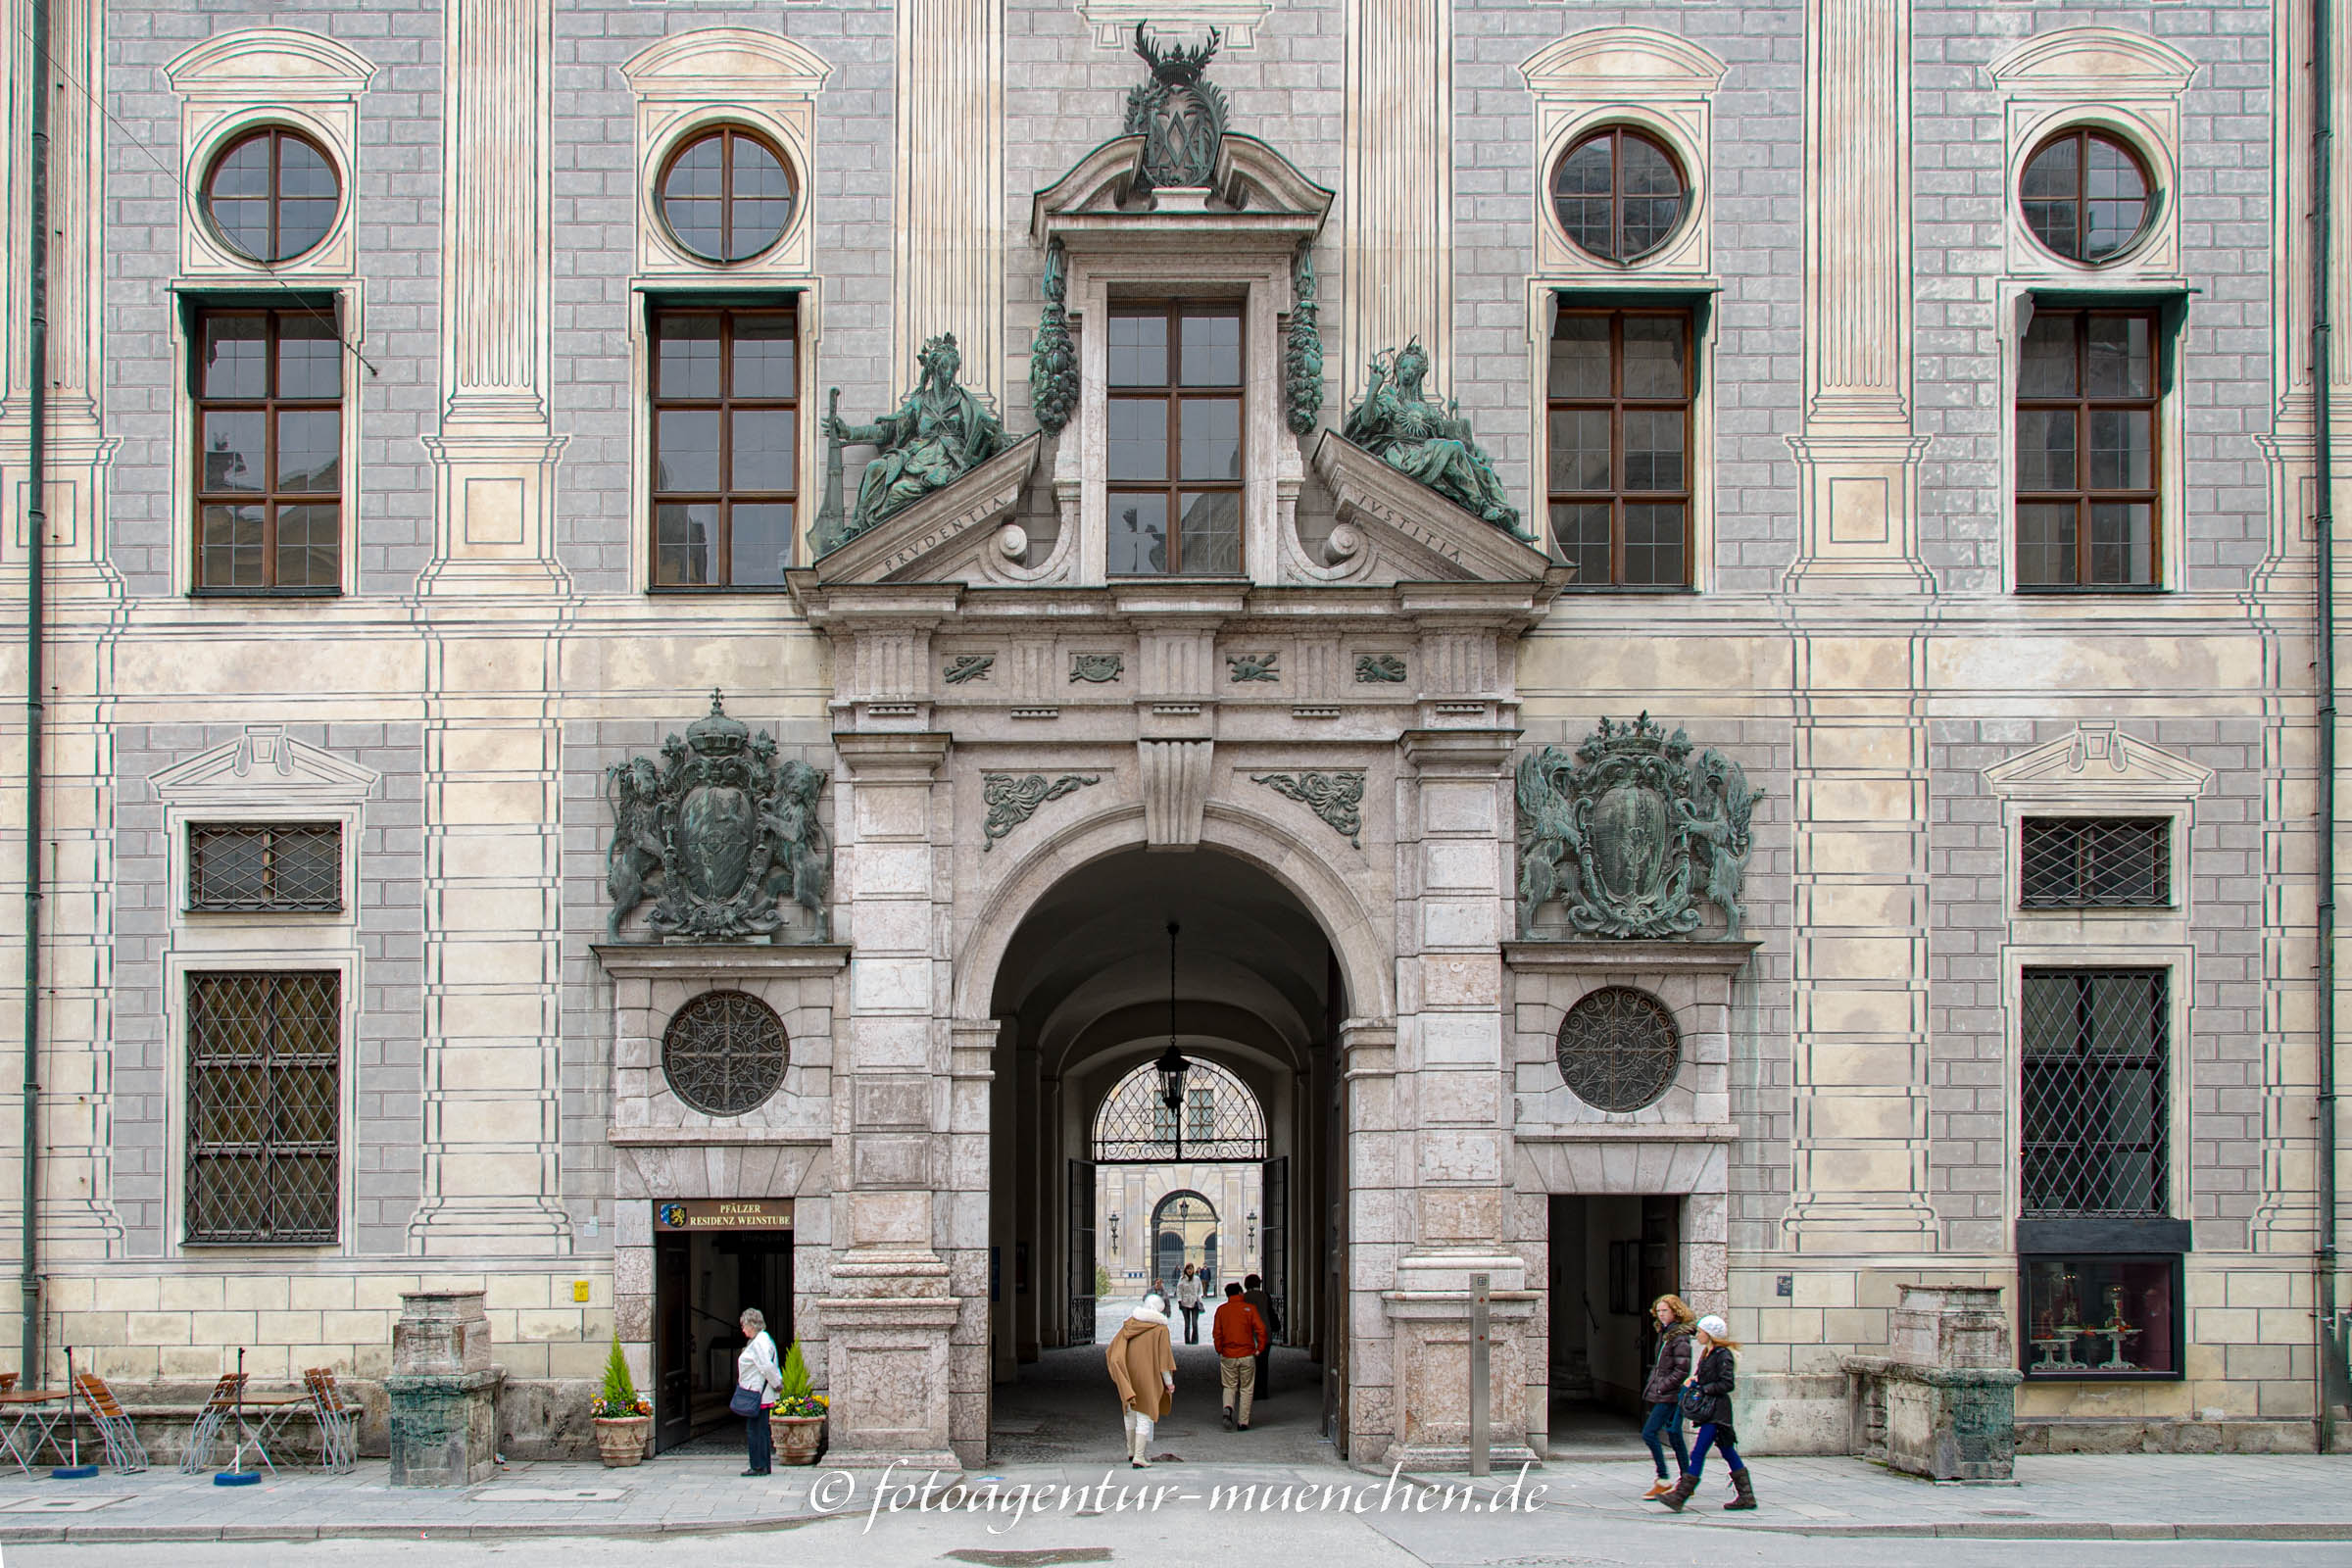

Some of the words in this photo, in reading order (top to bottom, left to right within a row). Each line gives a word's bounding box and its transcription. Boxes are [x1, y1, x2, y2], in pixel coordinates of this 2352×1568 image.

[720, 1202, 761, 1214] PFÄLZER
[690, 1216, 736, 1226] RESIDENZ
[738, 1215, 791, 1225] WEINSTUBE
